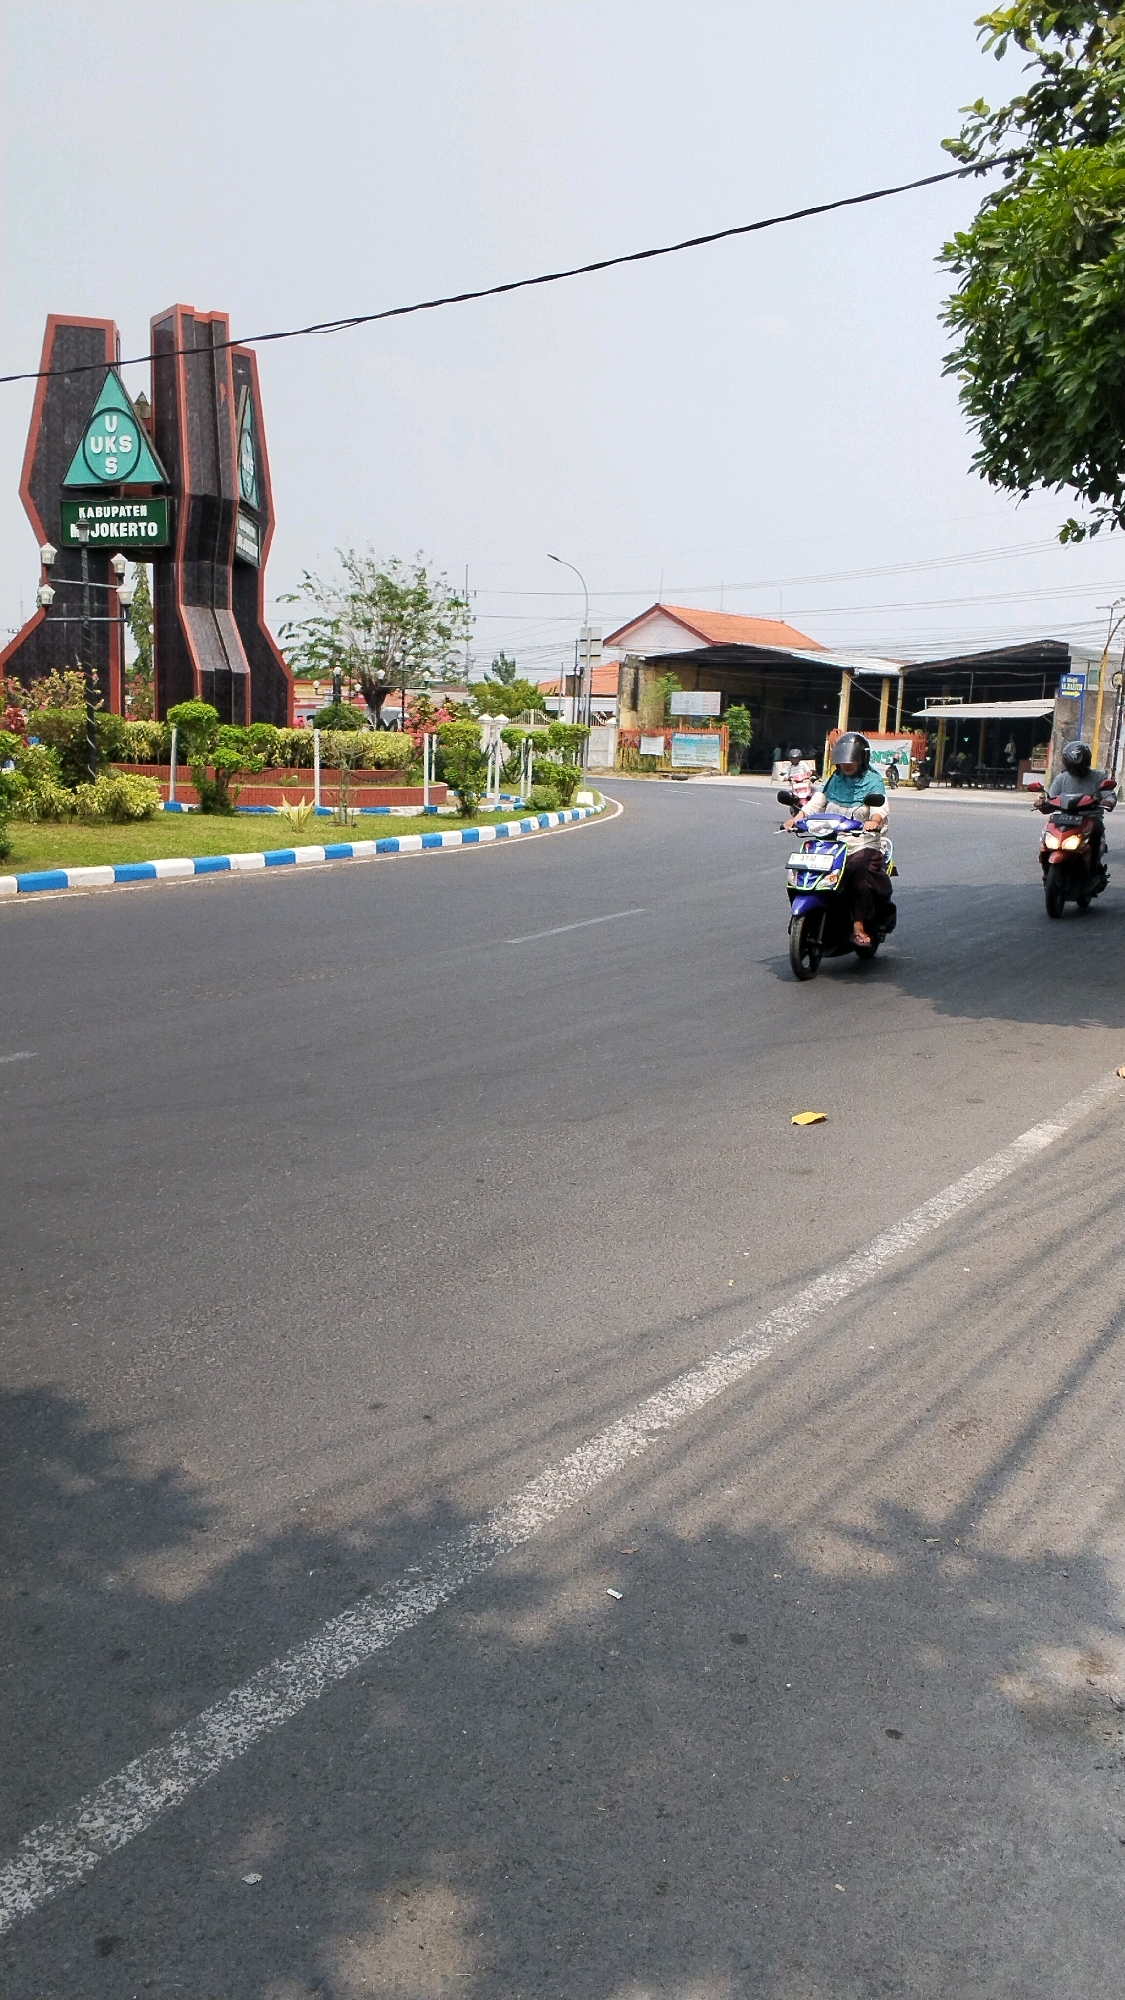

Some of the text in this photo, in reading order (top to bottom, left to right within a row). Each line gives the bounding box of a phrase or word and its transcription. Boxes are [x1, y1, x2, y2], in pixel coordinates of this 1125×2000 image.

[104, 415, 118, 432] U
[90, 434, 133, 454] UKS
[104, 456, 118, 474] S
[78, 504, 148, 519] KABUPATEN
[70, 521, 158, 538] MJOKERTO
